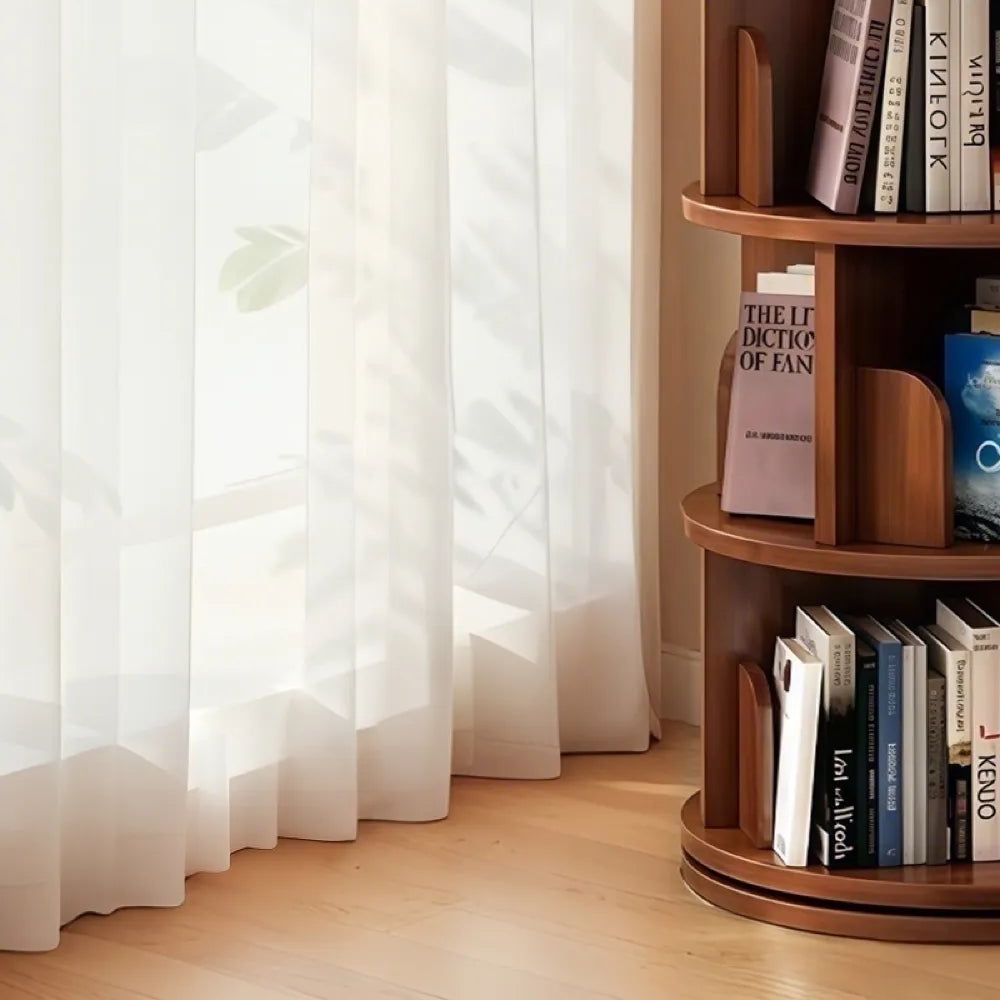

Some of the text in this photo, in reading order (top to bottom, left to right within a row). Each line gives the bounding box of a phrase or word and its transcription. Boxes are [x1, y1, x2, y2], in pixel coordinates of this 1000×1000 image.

[744, 304, 785, 325] THE
[740, 350, 814, 375] OF FAN
